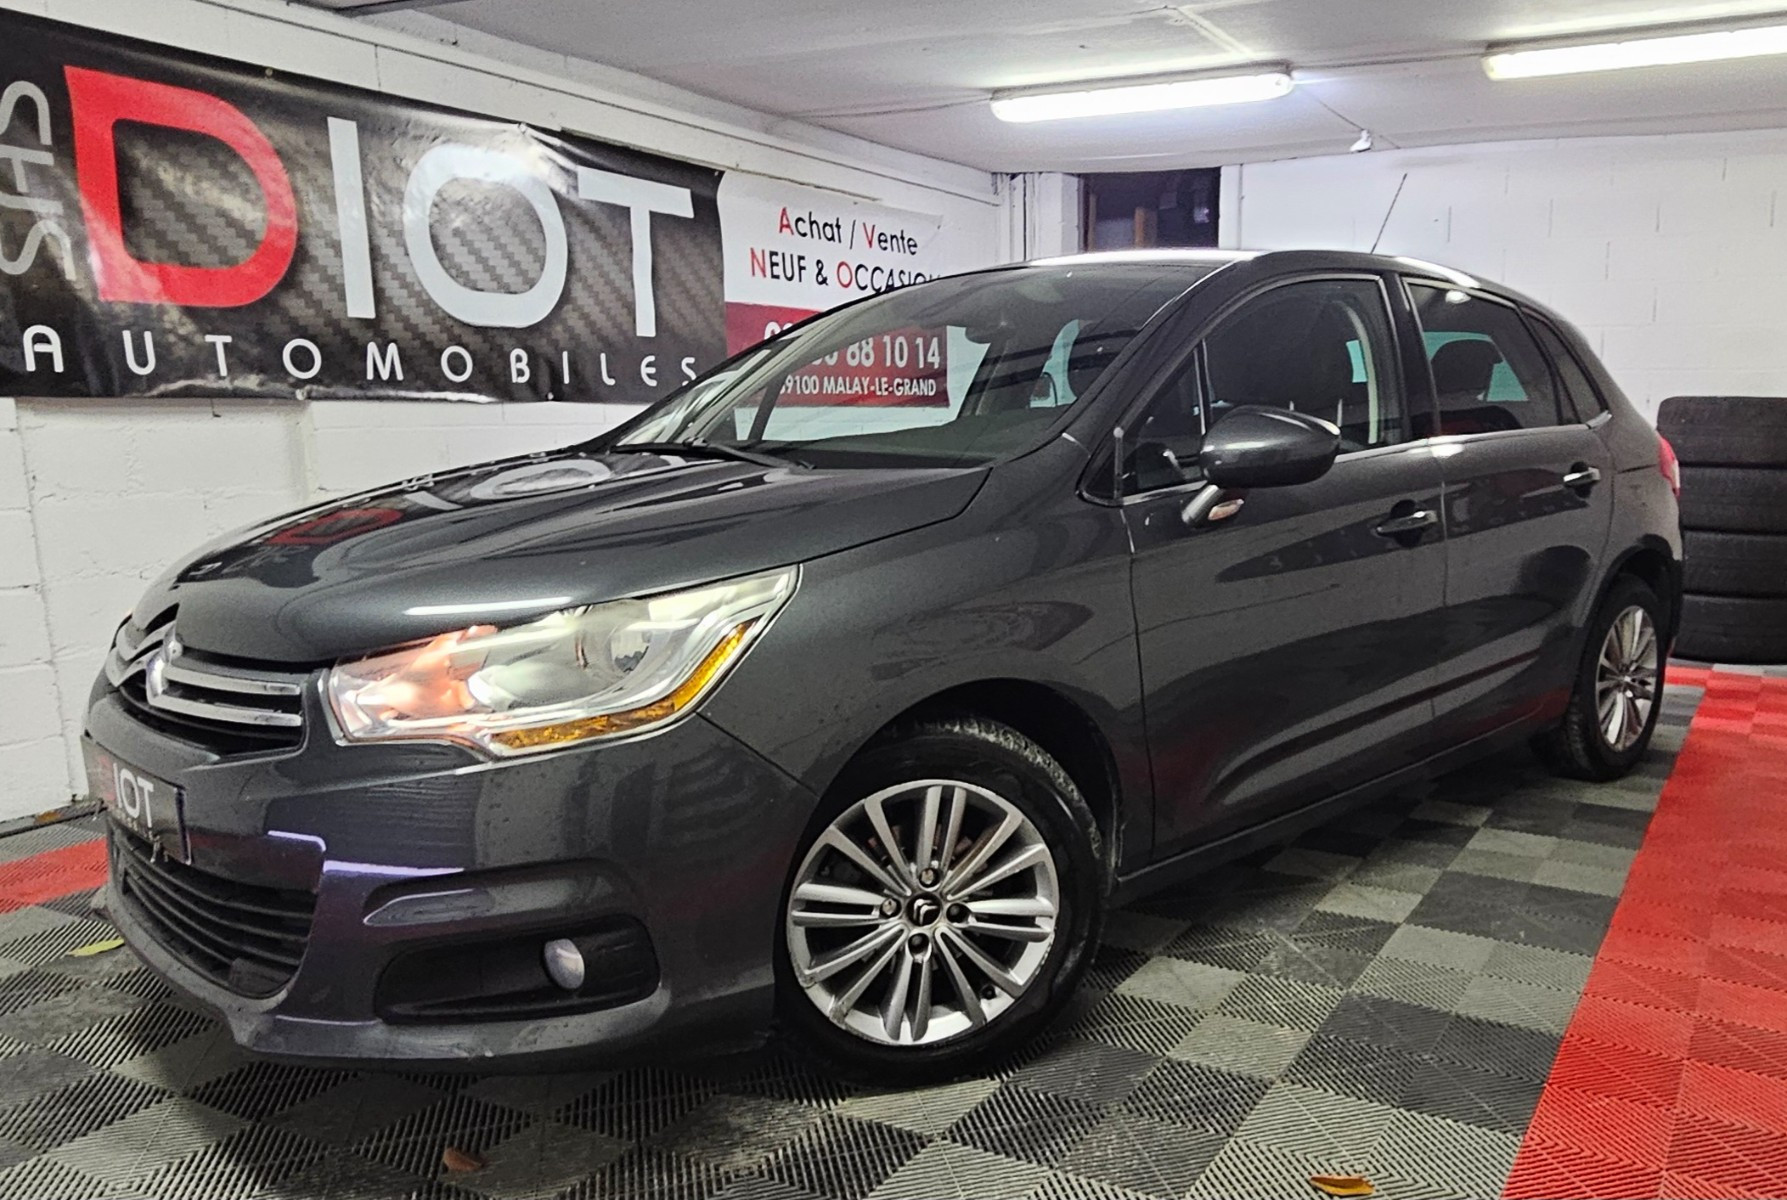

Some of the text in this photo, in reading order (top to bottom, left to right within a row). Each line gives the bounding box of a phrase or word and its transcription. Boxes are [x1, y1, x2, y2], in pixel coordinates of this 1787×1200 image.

[63, 65, 695, 338] DIOT
[778, 206, 918, 256] Achat / Vente
[750, 247, 942, 293] NEUF & OCCASI
[22, 324, 698, 388] AUTOMOBILES
[883, 335, 909, 368] 10
[915, 336, 942, 370] 14
[822, 376, 937, 396] MALAY-LE-GRAND
